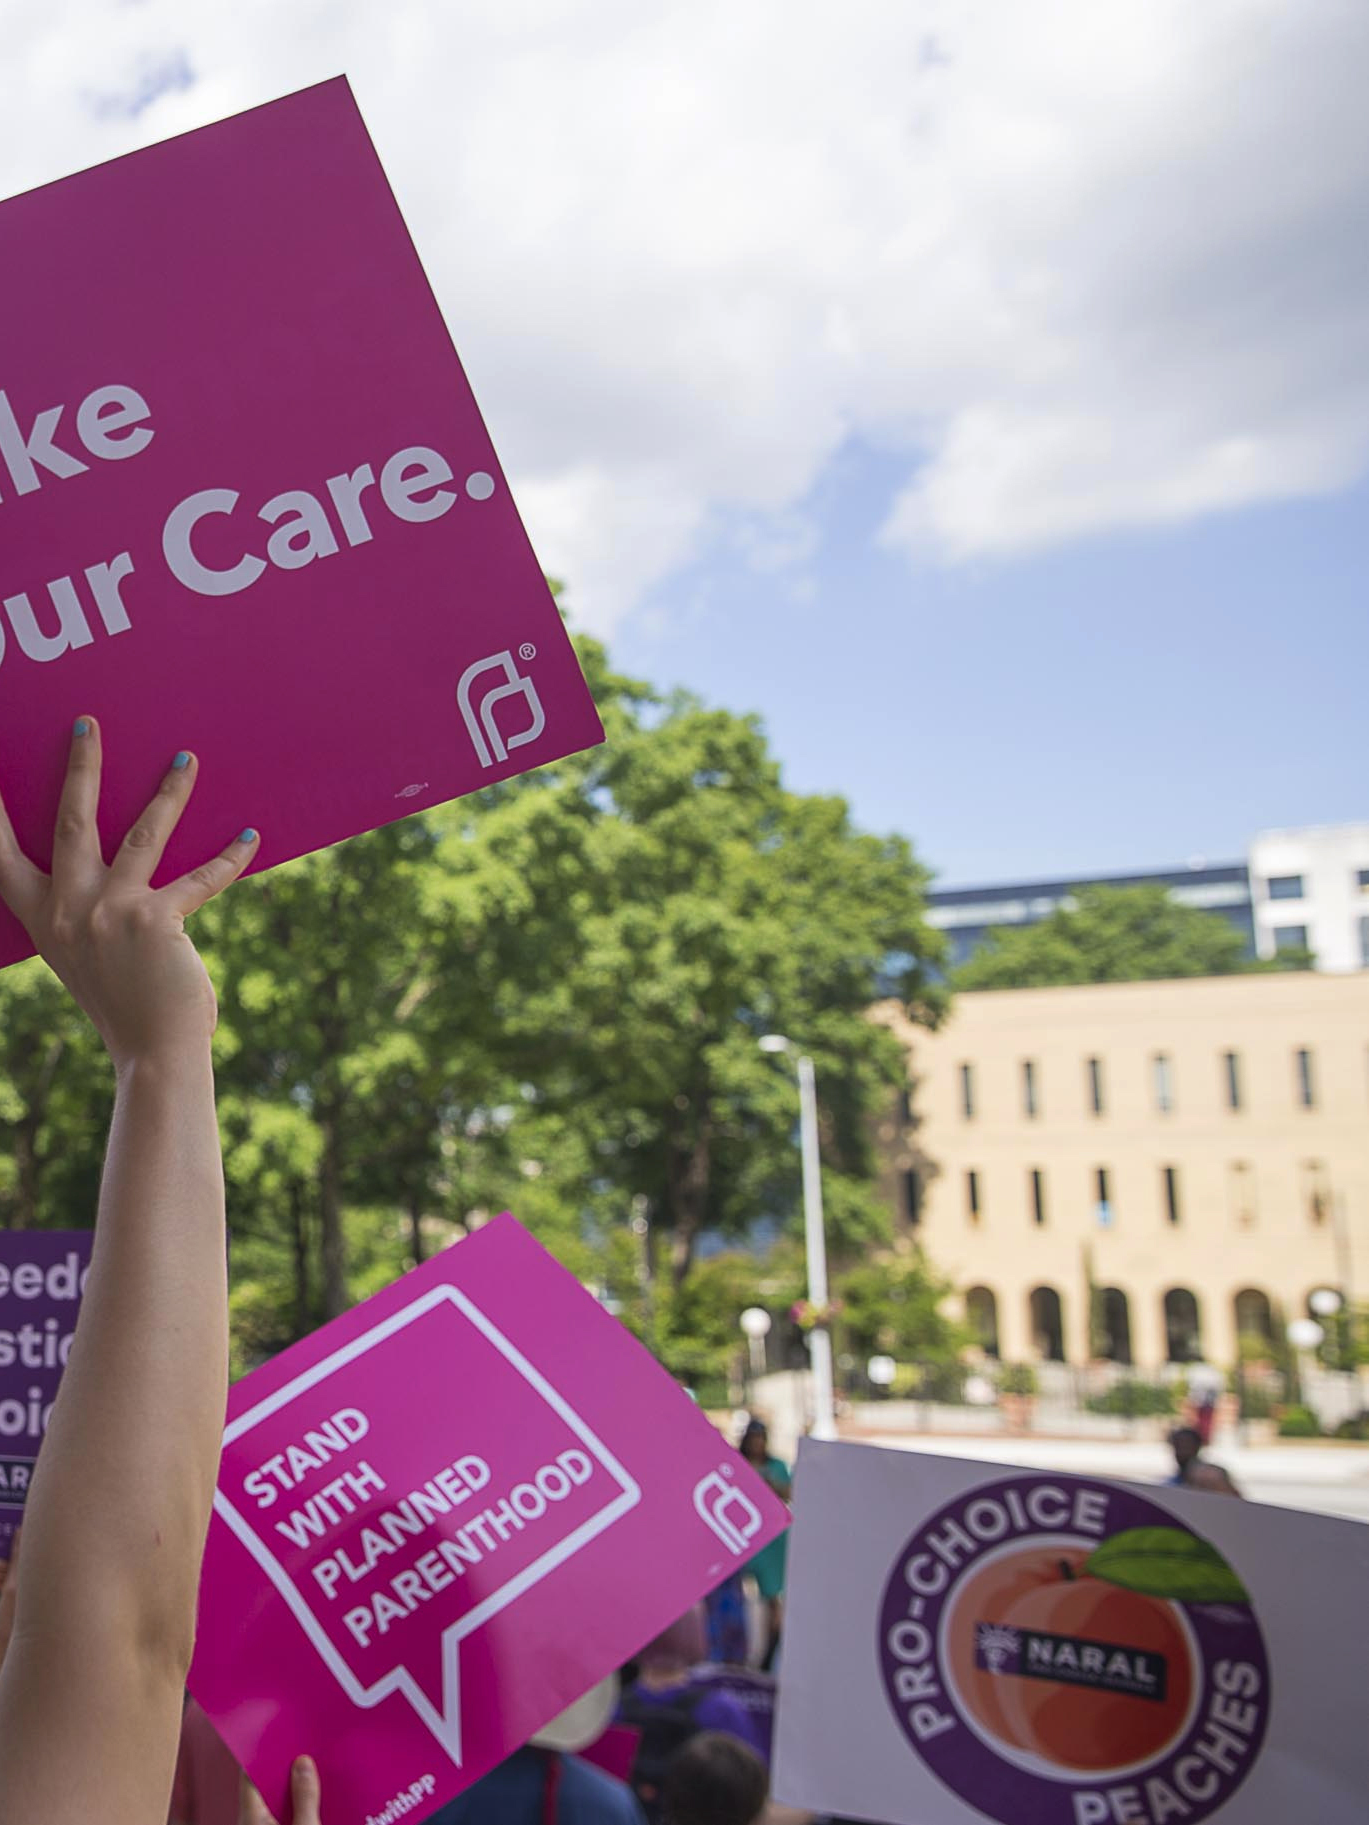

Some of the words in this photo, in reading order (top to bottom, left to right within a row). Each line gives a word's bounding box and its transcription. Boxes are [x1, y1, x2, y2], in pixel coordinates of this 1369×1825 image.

[162, 446, 496, 597] Care.
[243, 1407, 370, 1508] STAND
[275, 1460, 386, 1550] WITH
[311, 1455, 492, 1601] PLANNED
[342, 1449, 594, 1648] PARENTHOOD
[887, 1484, 1110, 1741] PRO-CHOICE
[1027, 1637, 1157, 1684] NARAL
[1072, 1659, 1261, 1825] PEACHES
